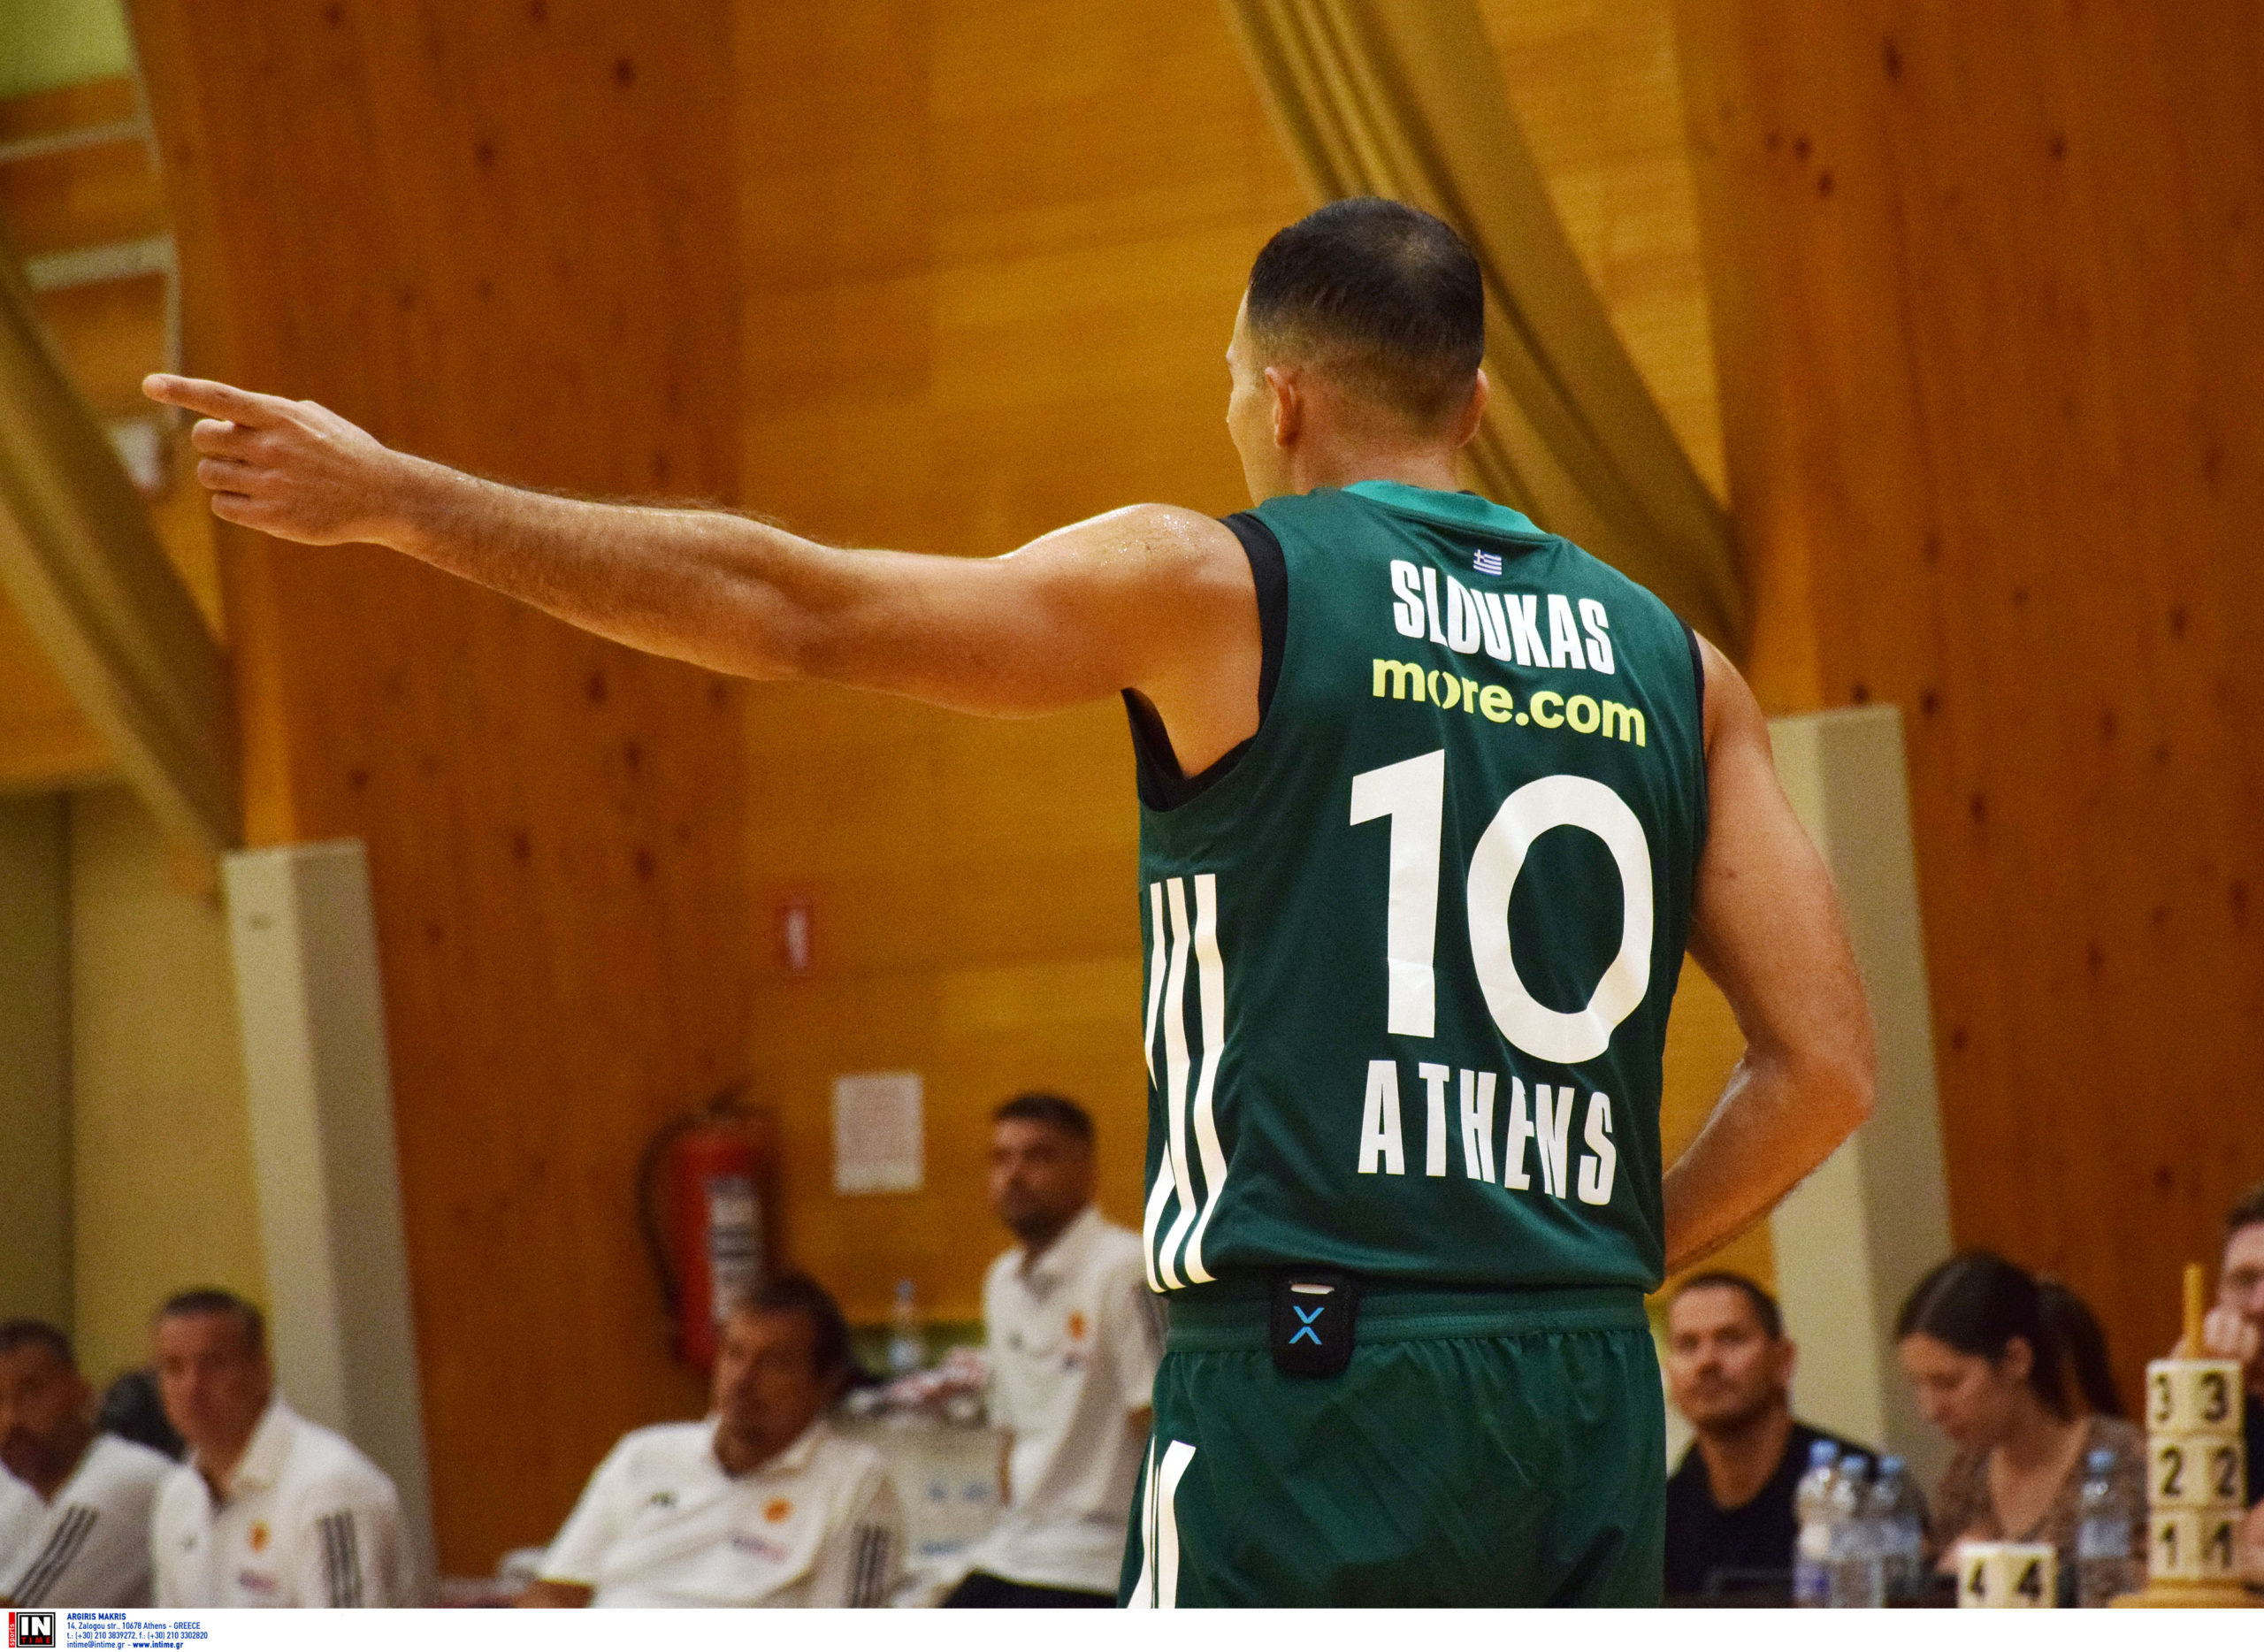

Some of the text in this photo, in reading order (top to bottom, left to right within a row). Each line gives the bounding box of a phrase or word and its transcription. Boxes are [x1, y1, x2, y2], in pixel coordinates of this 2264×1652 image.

[1389, 559, 1615, 675] SLOUKAS
[1373, 659, 1646, 747] more.com
[1350, 749, 1654, 1064] 10
[1358, 1059, 1617, 1205] ATHENS
[2199, 1370, 2230, 1422] 3
[2159, 1445, 2238, 1497] 2 2
[1968, 1557, 2042, 1599] 4 4
[2161, 1521, 2234, 1569] 1 1
